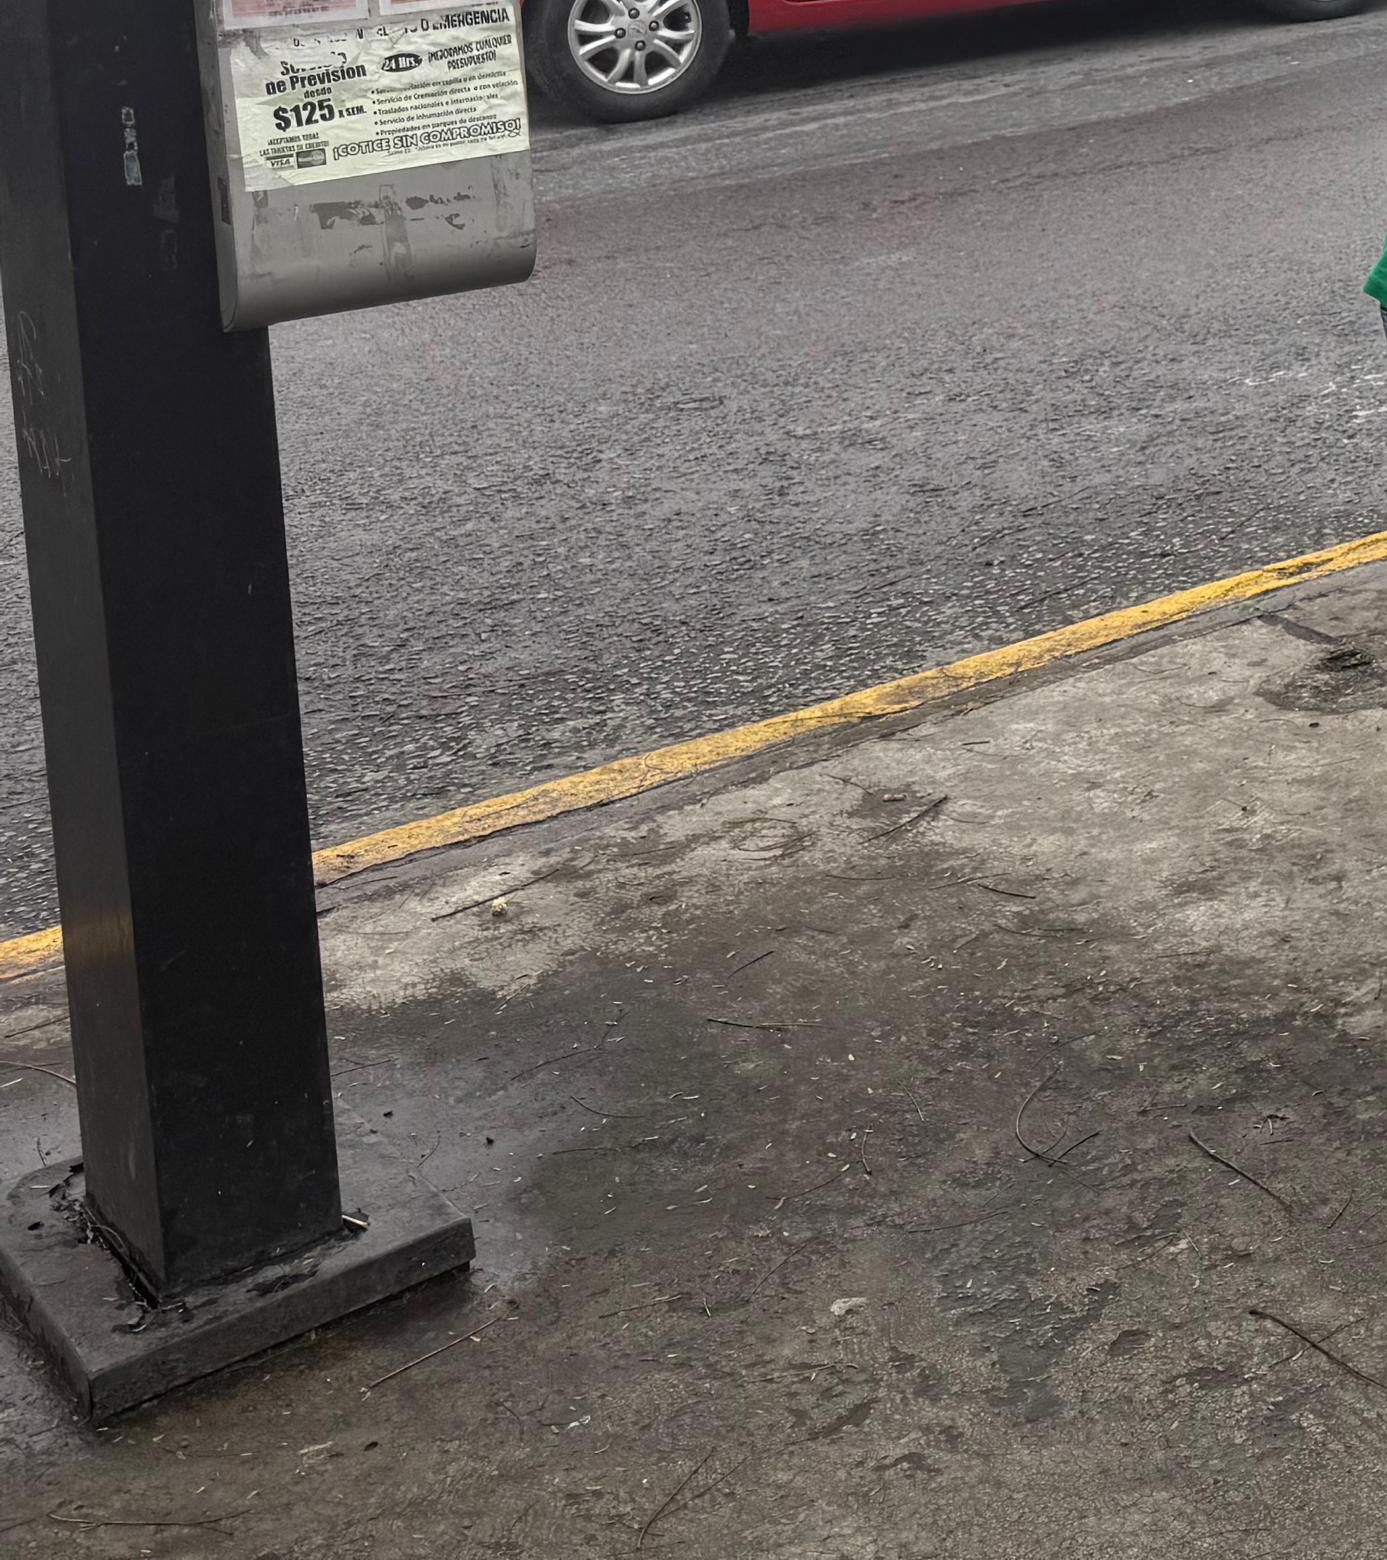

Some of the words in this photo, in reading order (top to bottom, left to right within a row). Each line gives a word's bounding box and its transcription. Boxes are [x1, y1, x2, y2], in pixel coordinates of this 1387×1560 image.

[384, 57, 396, 70] 24
[289, 64, 367, 91] Prevision
[303, 86, 333, 99] desde
[273, 98, 336, 132] $125
[333, 137, 390, 161] ¡COTICE
[393, 133, 419, 149] SIN
[420, 117, 522, 144] COMPROMISO!
[270, 158, 291, 167] VISA
